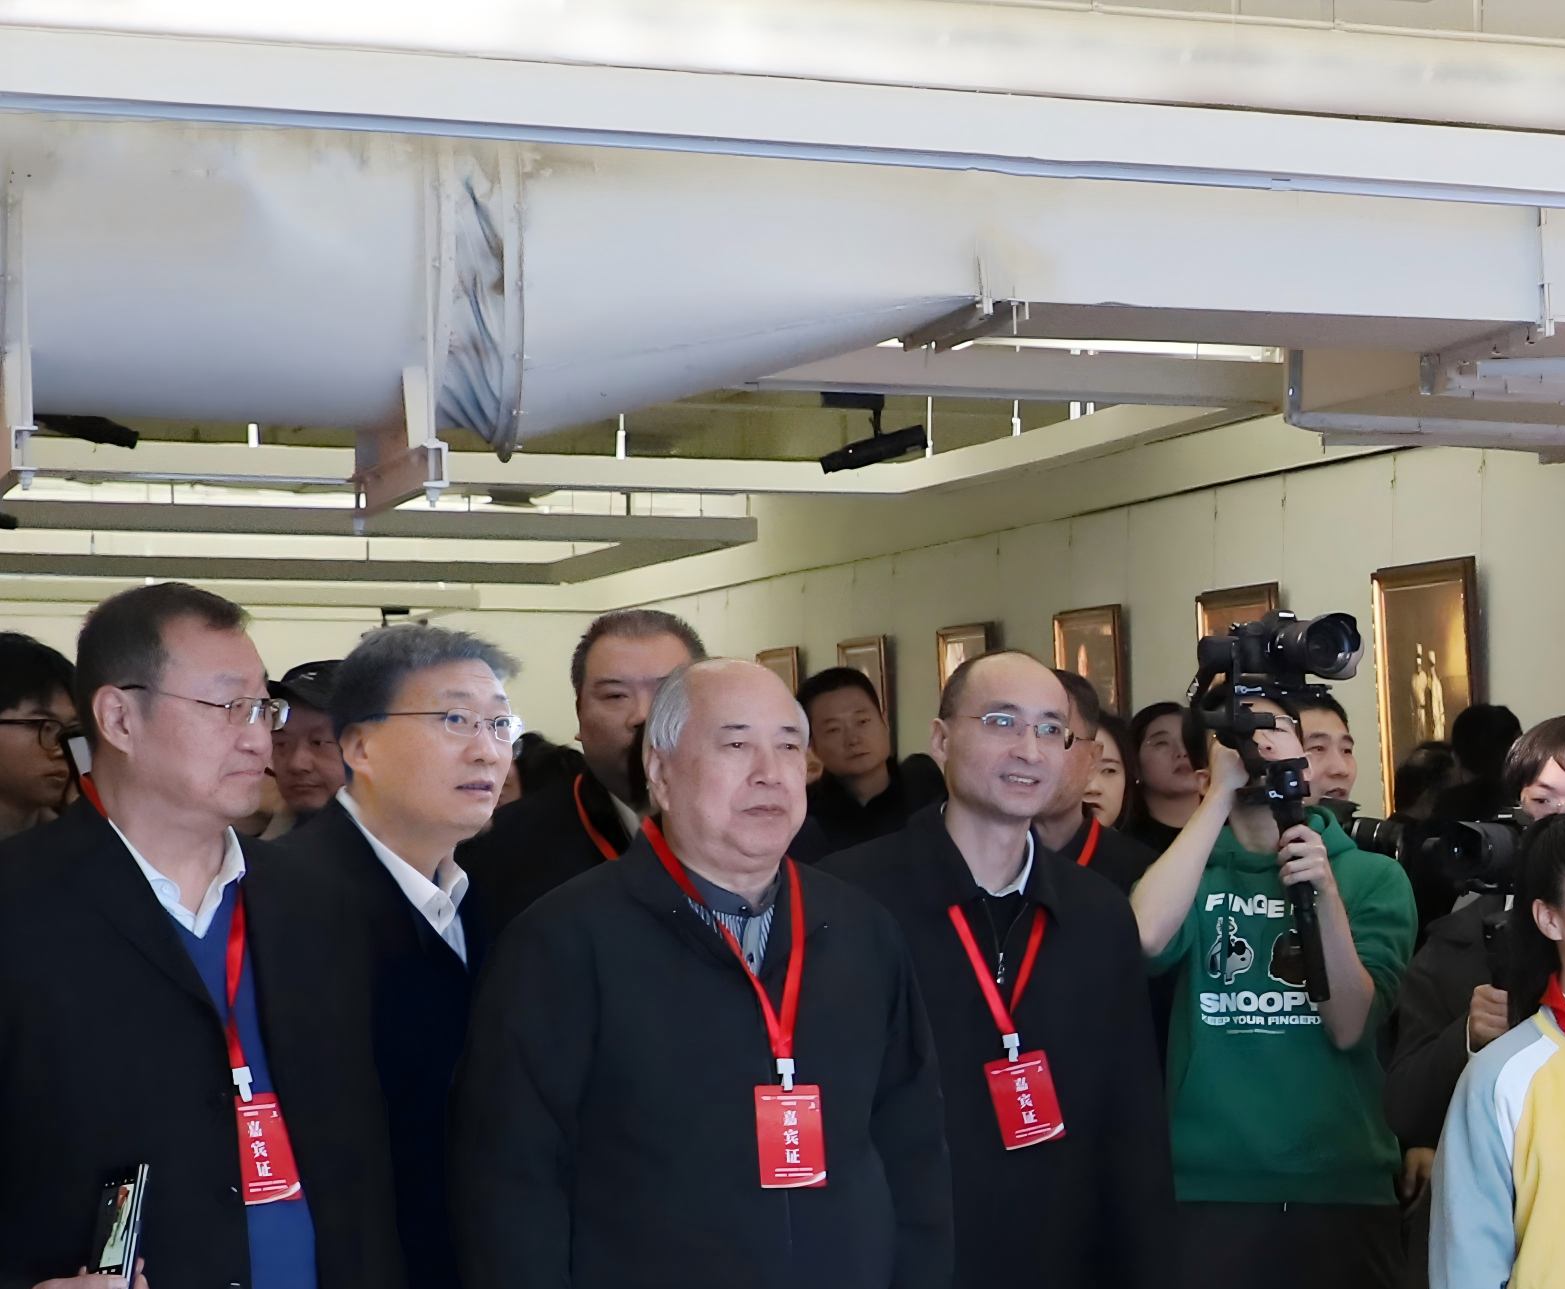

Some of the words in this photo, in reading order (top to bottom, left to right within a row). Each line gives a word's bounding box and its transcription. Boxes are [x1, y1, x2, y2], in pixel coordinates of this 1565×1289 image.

[1205, 893, 1295, 918] FINGE
[1233, 1015, 1265, 1025] YOUR
[1014, 1077, 1038, 1124] 嘉宾证
[247, 1120, 273, 1177] 嘉宾证
[783, 1110, 800, 1164] 嘉宾证
